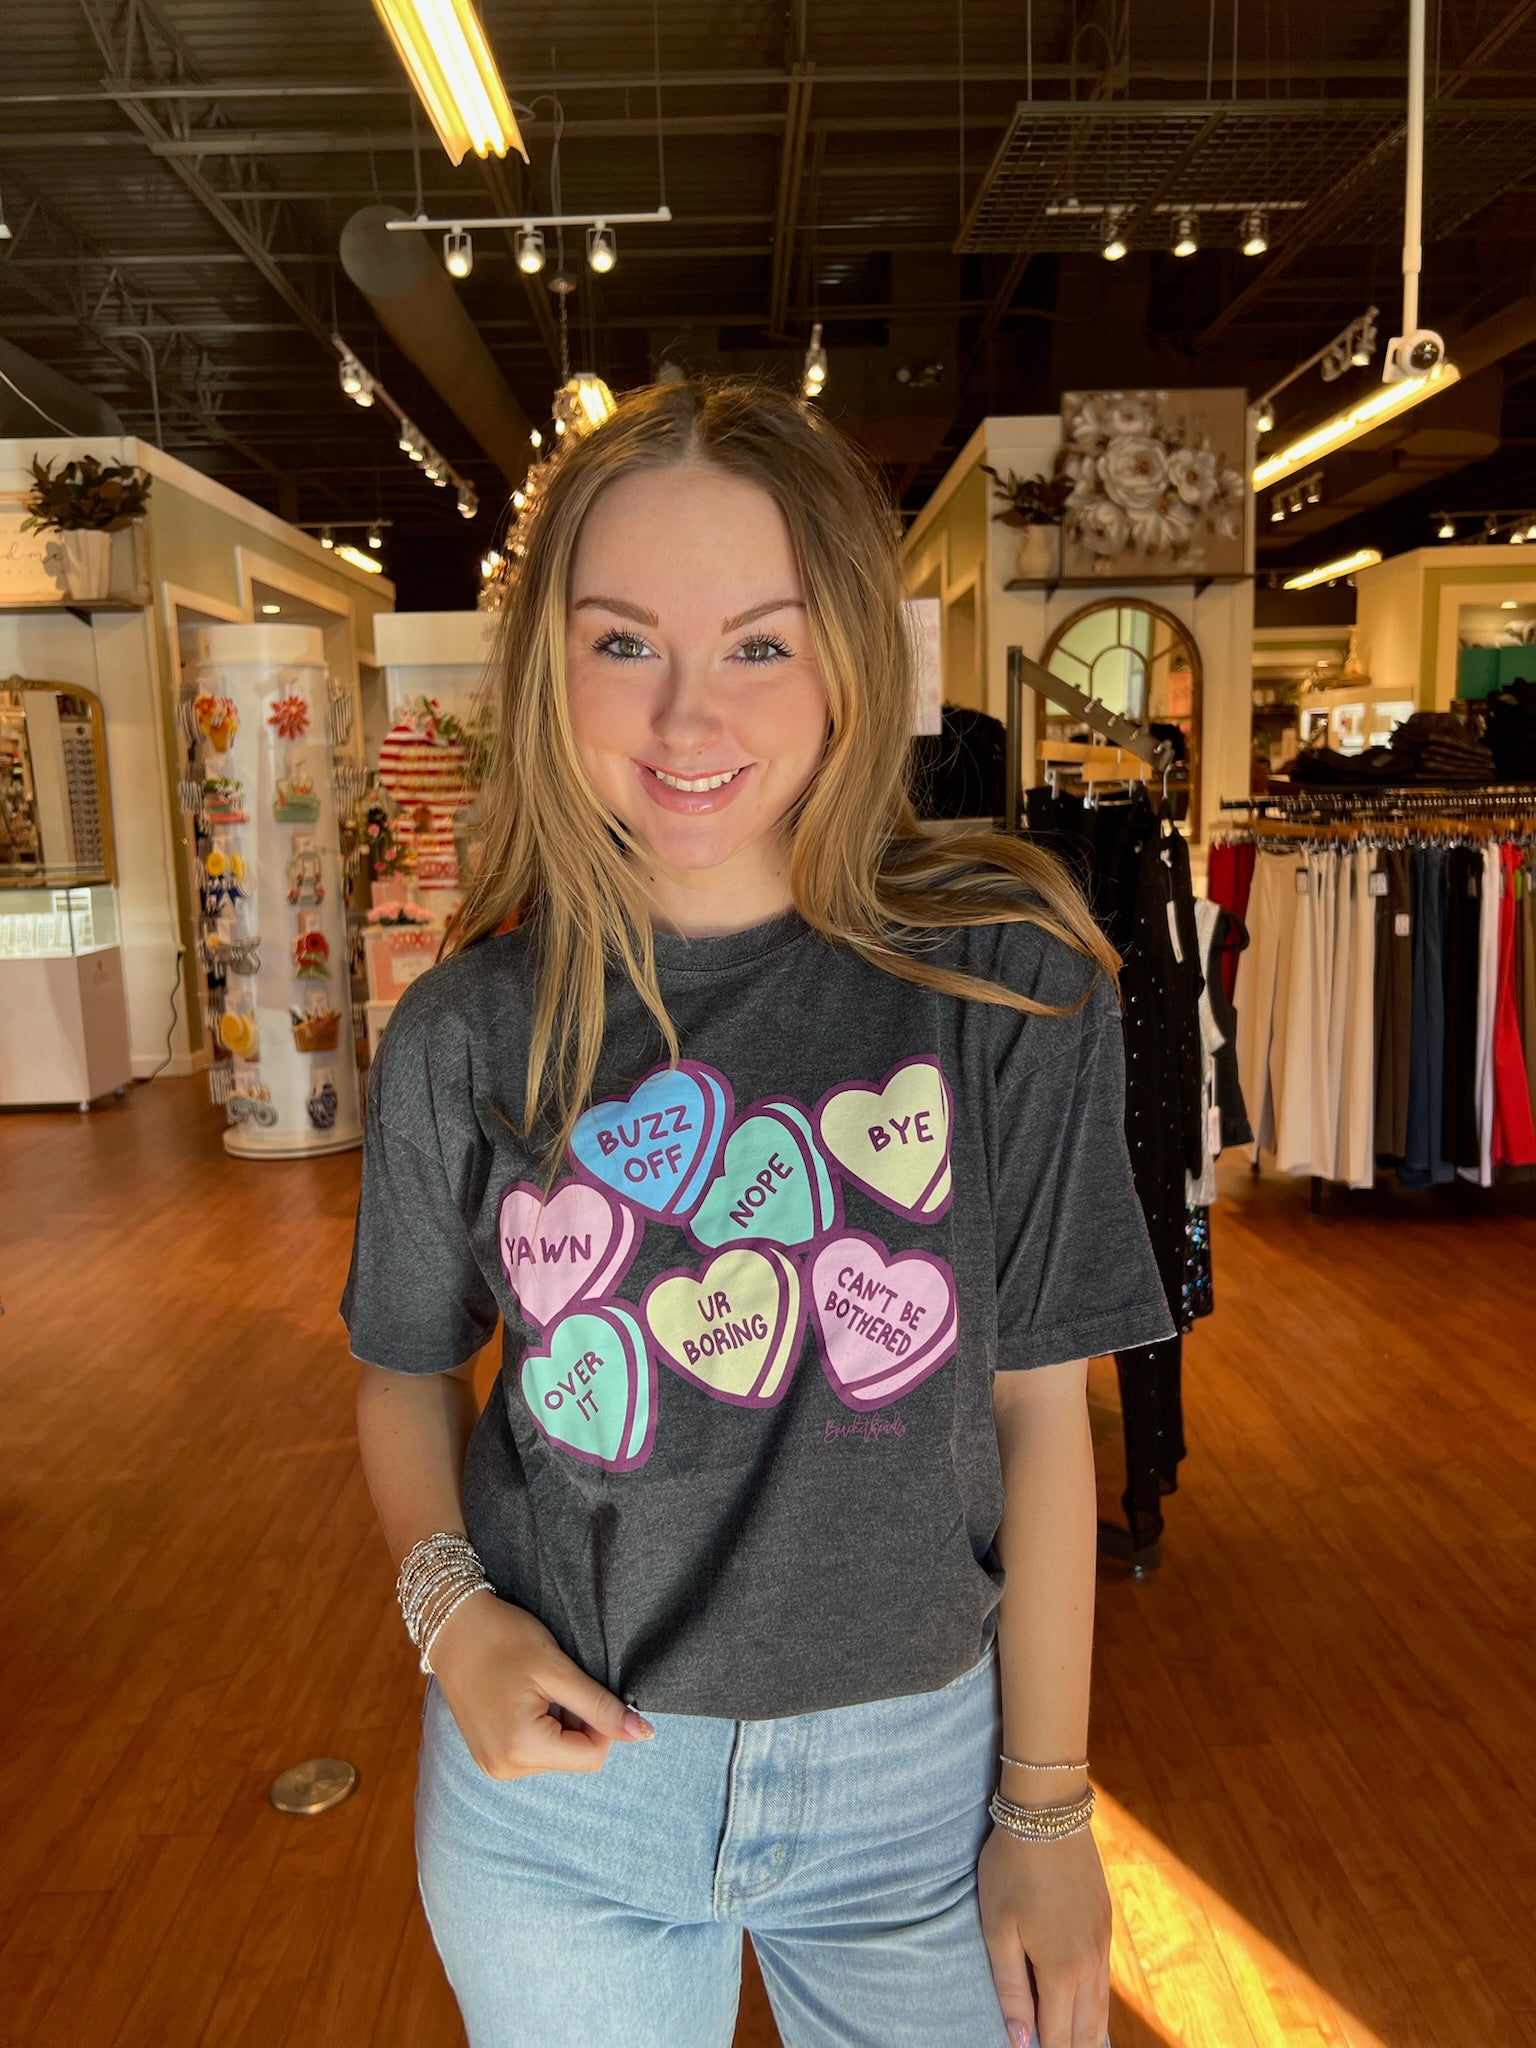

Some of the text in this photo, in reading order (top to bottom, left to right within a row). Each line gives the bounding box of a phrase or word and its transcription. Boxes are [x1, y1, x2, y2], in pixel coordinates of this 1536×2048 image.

[597, 1105, 692, 1156] BUZZ
[868, 1111, 933, 1152] BYE
[624, 1144, 681, 1182] OFF
[729, 1152, 793, 1228] NOPE
[504, 1234, 592, 1266] YAWN
[698, 1292, 731, 1322] UR
[824, 1290, 912, 1357] BOTHERED
[838, 1267, 926, 1330] CAN'T BE
[683, 1314, 767, 1365] BORING
[545, 1352, 604, 1410] OVER
[576, 1392, 598, 1421] IT
